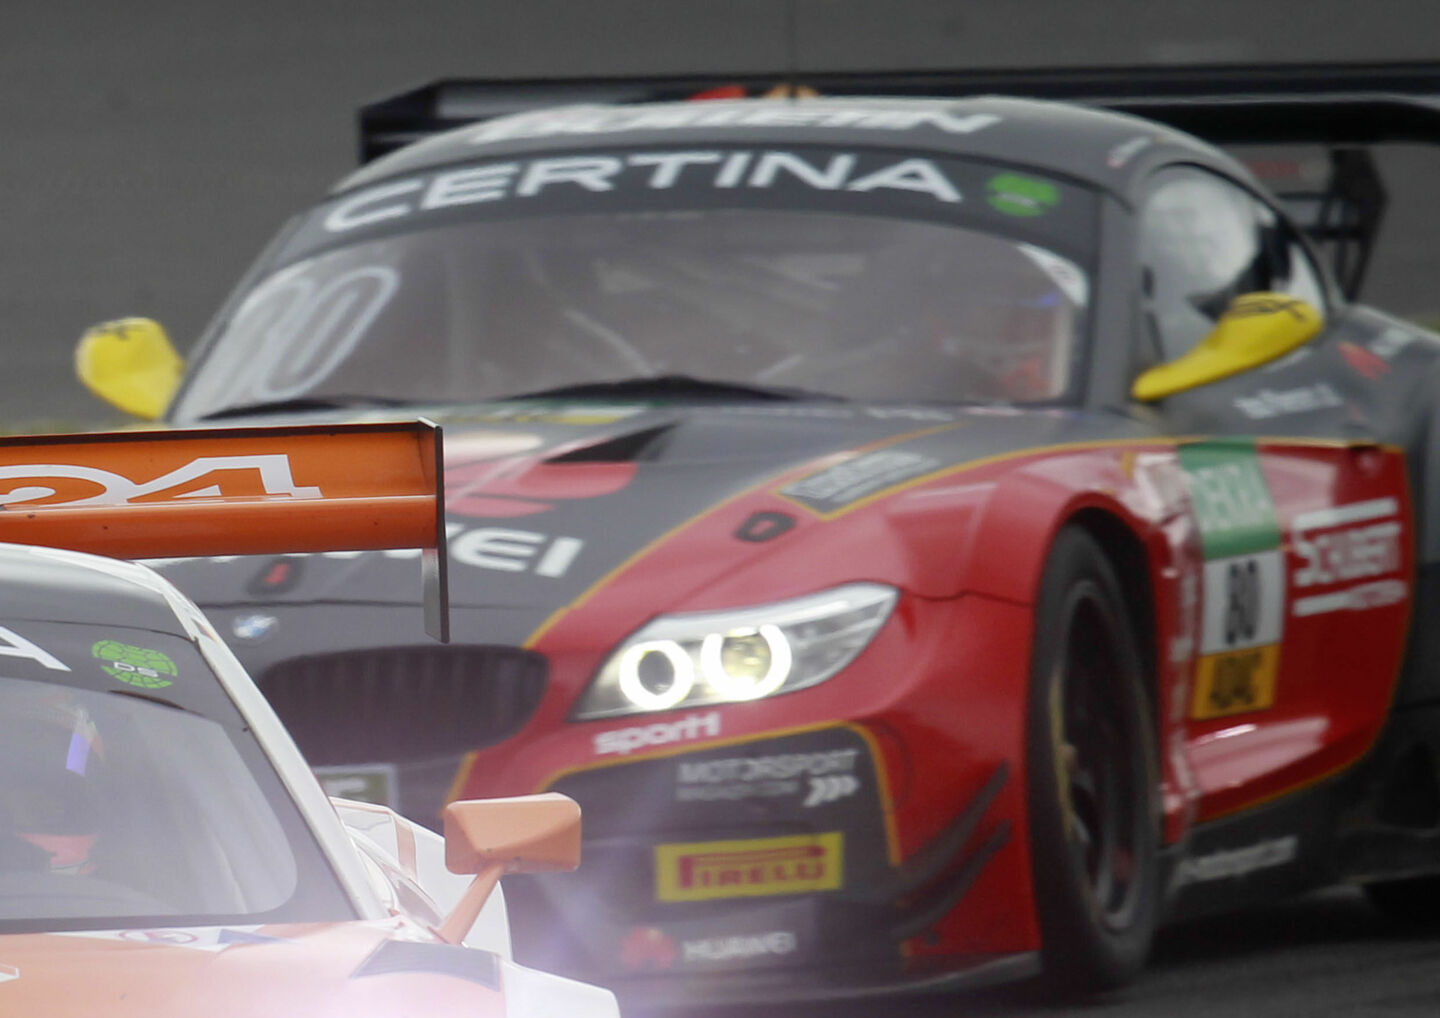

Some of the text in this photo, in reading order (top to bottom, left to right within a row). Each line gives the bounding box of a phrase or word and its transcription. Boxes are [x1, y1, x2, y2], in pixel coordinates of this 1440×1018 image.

[324, 151, 962, 232] CERTINA
[113, 661, 159, 678] DS
[676, 844, 827, 890] PIRELLI
